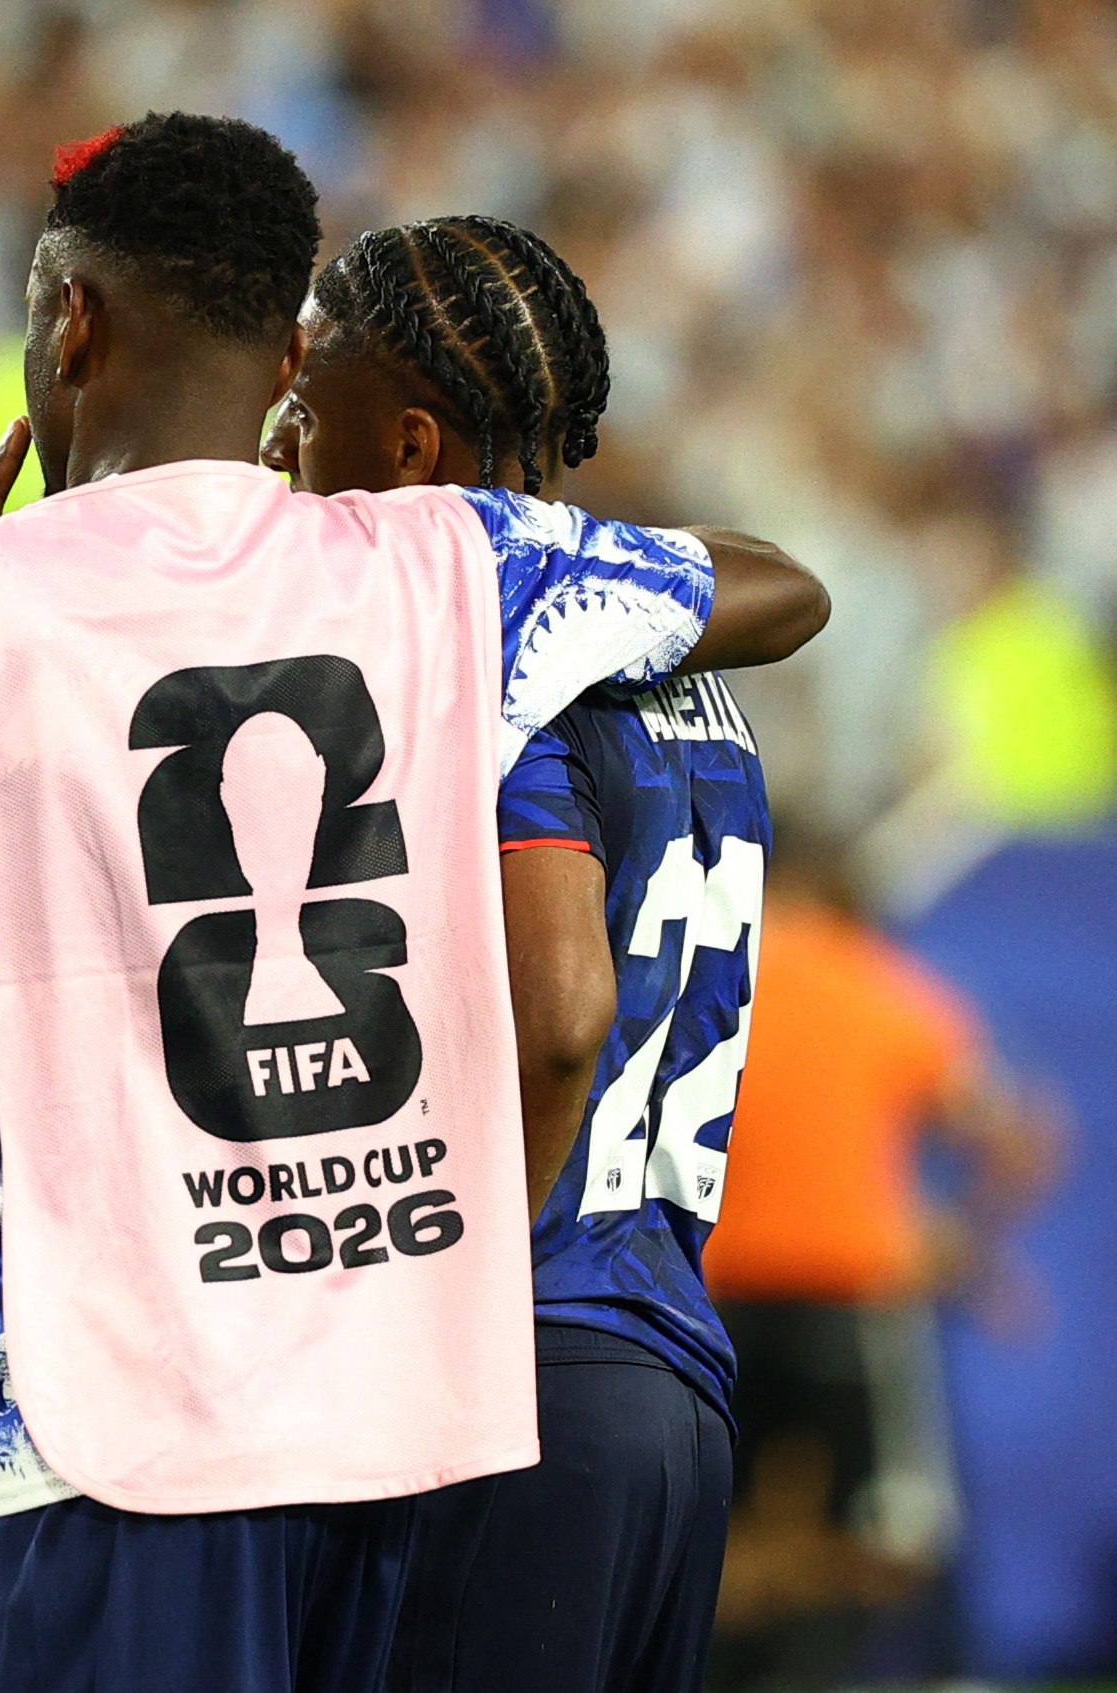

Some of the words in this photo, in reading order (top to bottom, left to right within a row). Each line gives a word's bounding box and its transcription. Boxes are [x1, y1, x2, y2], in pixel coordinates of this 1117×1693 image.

[246, 1037, 371, 1096] FIFA
[577, 836, 764, 1223] 22
[182, 1155, 355, 1208] WORLD
[363, 1138, 447, 1188] CUP
[193, 1189, 464, 1283] 2026
